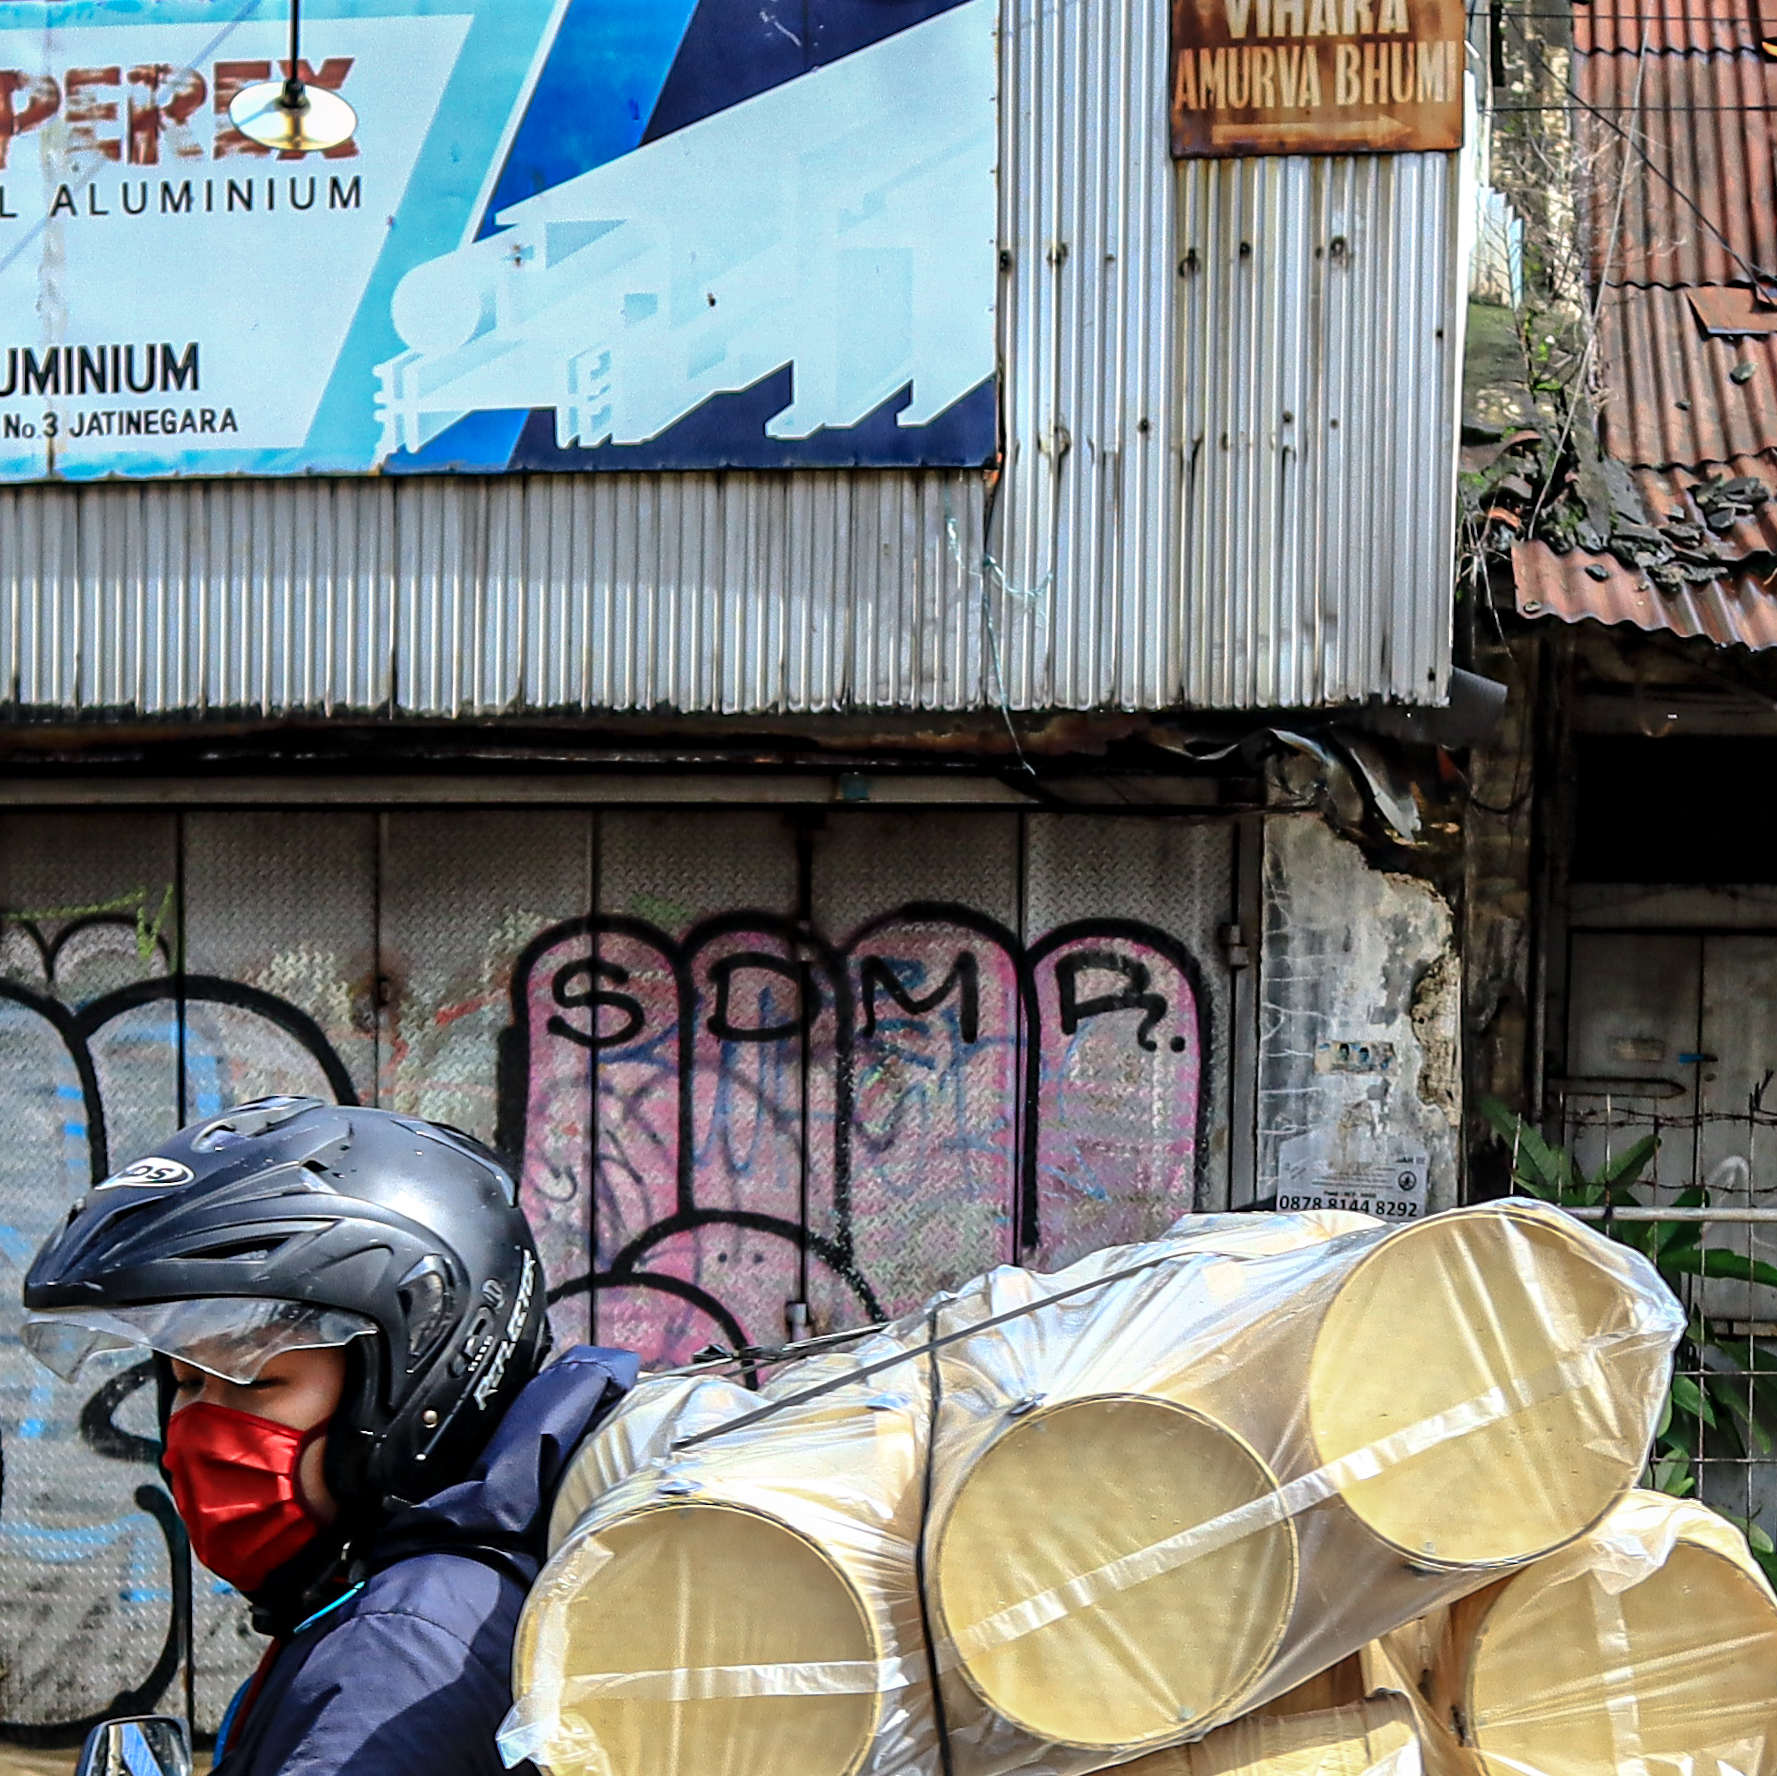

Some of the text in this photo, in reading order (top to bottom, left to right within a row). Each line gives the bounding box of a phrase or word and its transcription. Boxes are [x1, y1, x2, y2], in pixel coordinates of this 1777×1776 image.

[1225, 0, 1410, 39] VIHARA
[1175, 40, 1458, 111] AMURVA BHUMI
[50, 175, 362, 218] ALUMINIUM
[69, 407, 239, 438] JATINEGARA
[1279, 1194, 1323, 1210] 0878
[1375, 1200, 1418, 1218] 8292
